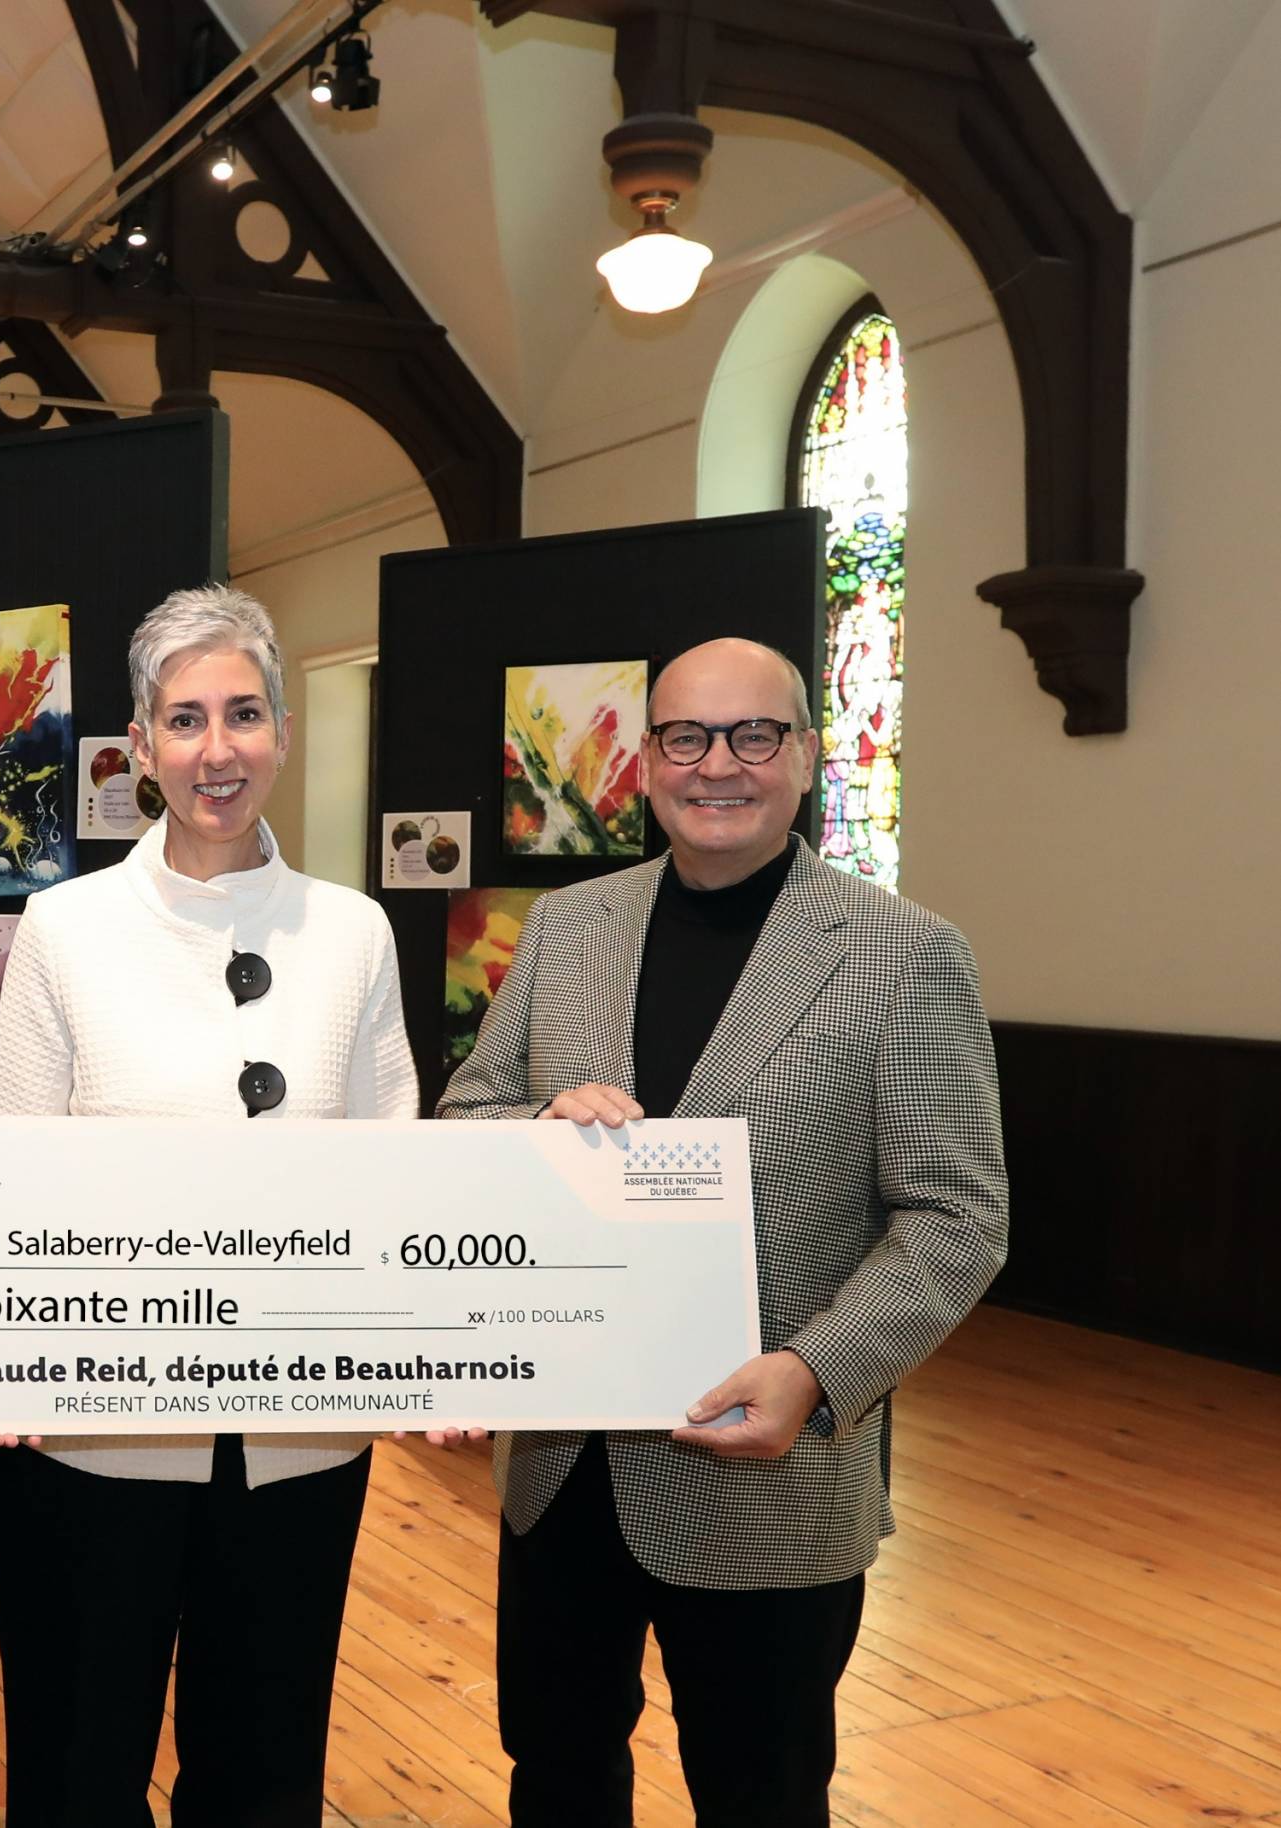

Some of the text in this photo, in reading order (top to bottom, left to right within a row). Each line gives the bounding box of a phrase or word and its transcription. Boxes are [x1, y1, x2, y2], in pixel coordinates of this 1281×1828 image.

[624, 1176, 723, 1185] ASSEMBLÉE NATIONALE
[664, 1187, 697, 1196] QUÉBEC
[8, 1230, 349, 1262] Salaberry-de-Valleyfield
[381, 1233, 536, 1270] $ 60,000.
[143, 1289, 238, 1325] mille
[532, 1310, 604, 1322] DOLLARS
[77, 1357, 154, 1387] Reid,
[165, 1355, 278, 1388] député
[287, 1356, 326, 1381] de
[336, 1354, 535, 1380] Beauharnois
[56, 1389, 433, 1413] PRÉSENT DANS VOTRE COMMUNAUTÉ
